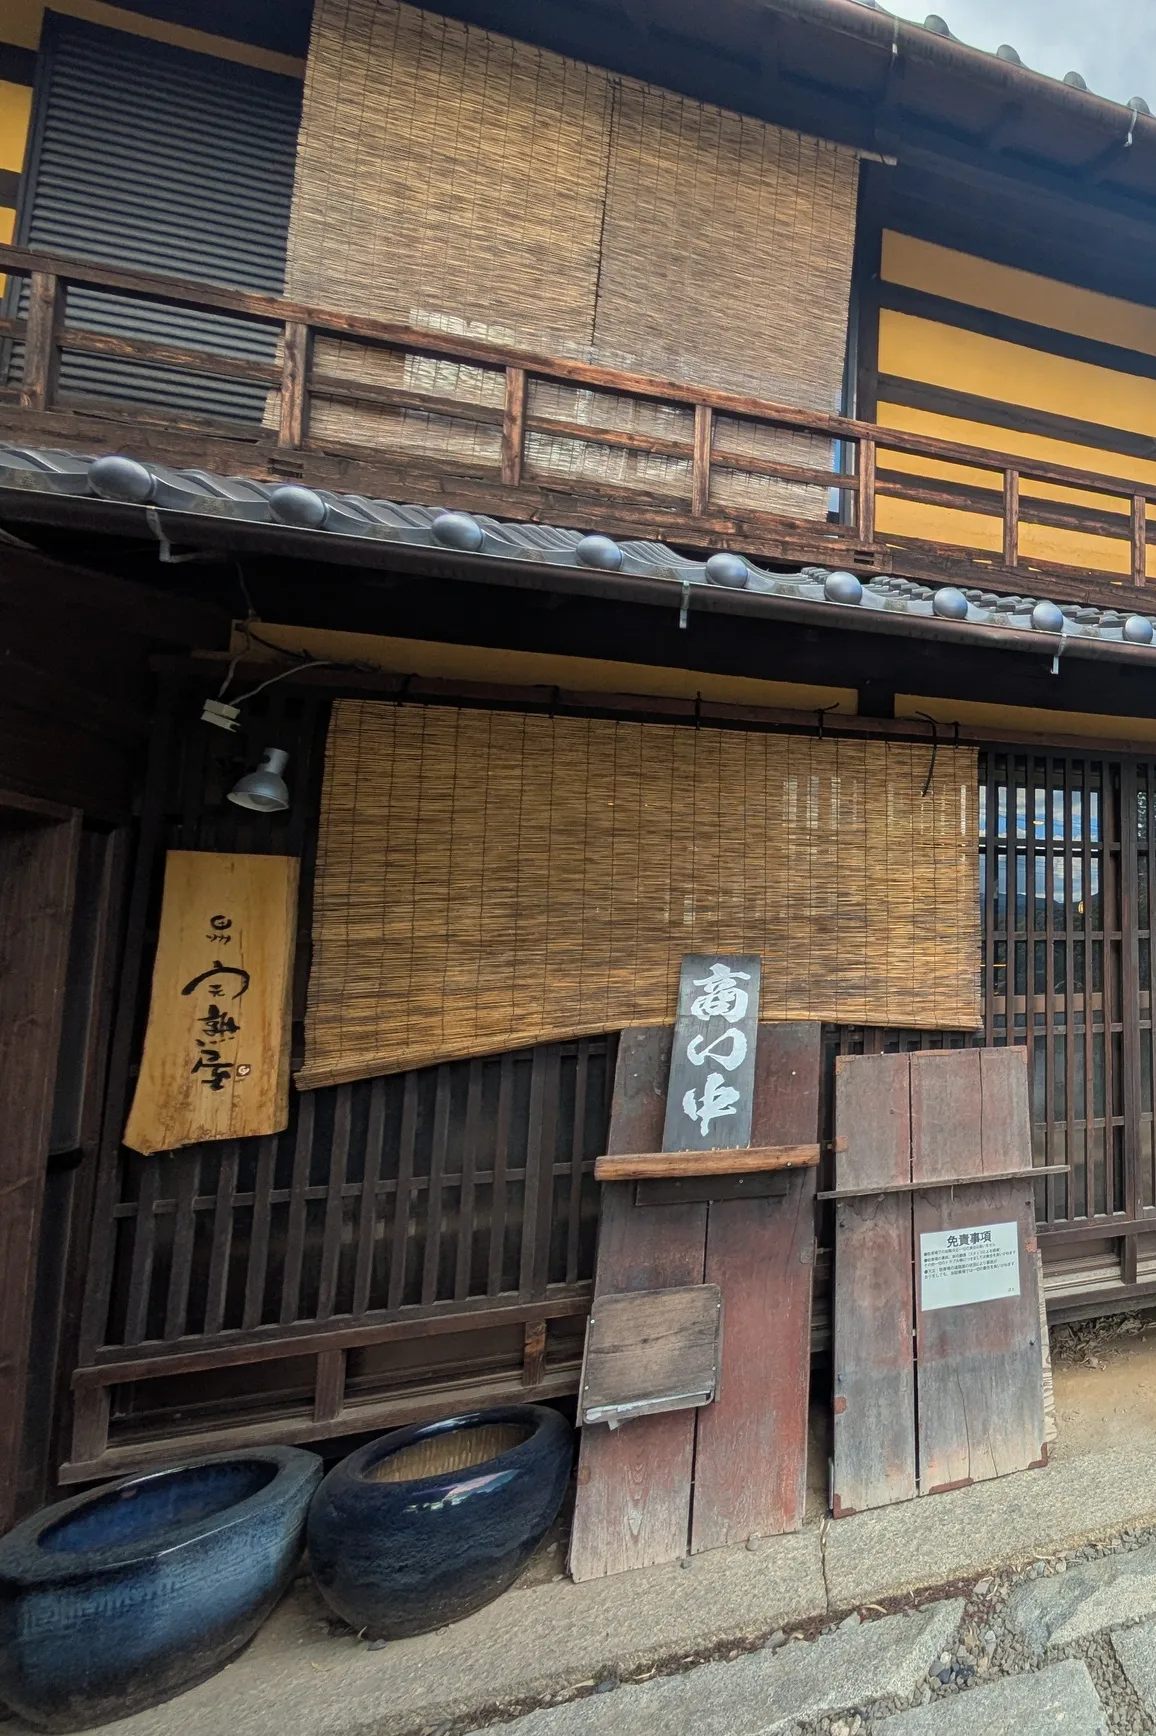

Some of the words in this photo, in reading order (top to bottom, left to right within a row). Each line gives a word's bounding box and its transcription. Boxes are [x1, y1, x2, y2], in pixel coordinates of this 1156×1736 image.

[682, 963, 751, 1136] 商い中
[947, 1231, 991, 1248] 免責事項
